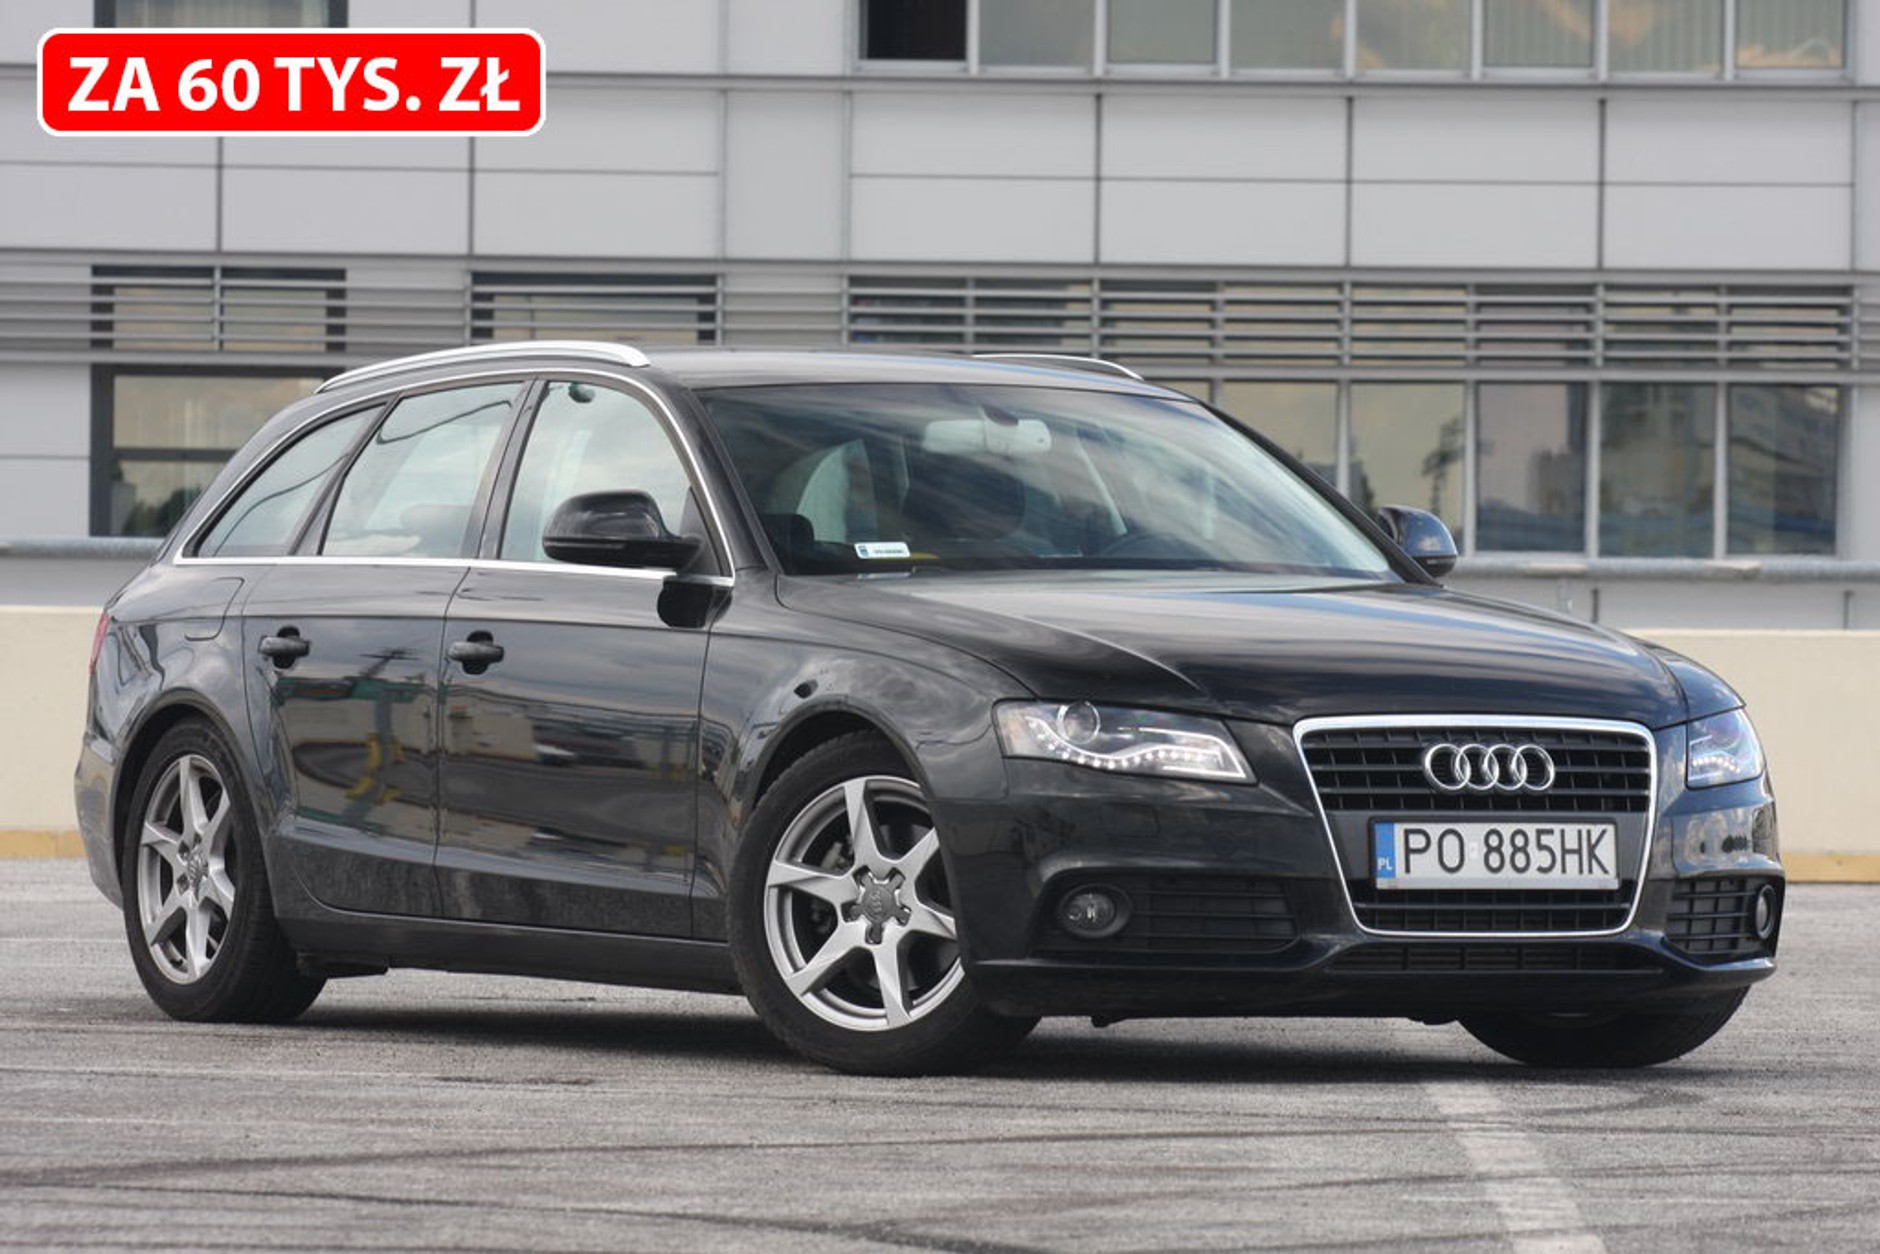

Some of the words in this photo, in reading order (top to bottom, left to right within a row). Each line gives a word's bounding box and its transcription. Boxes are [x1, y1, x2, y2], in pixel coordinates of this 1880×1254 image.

[1377, 858, 1393, 870] PL
[1404, 828, 1465, 874] PO
[1484, 828, 1609, 874] 885HK
